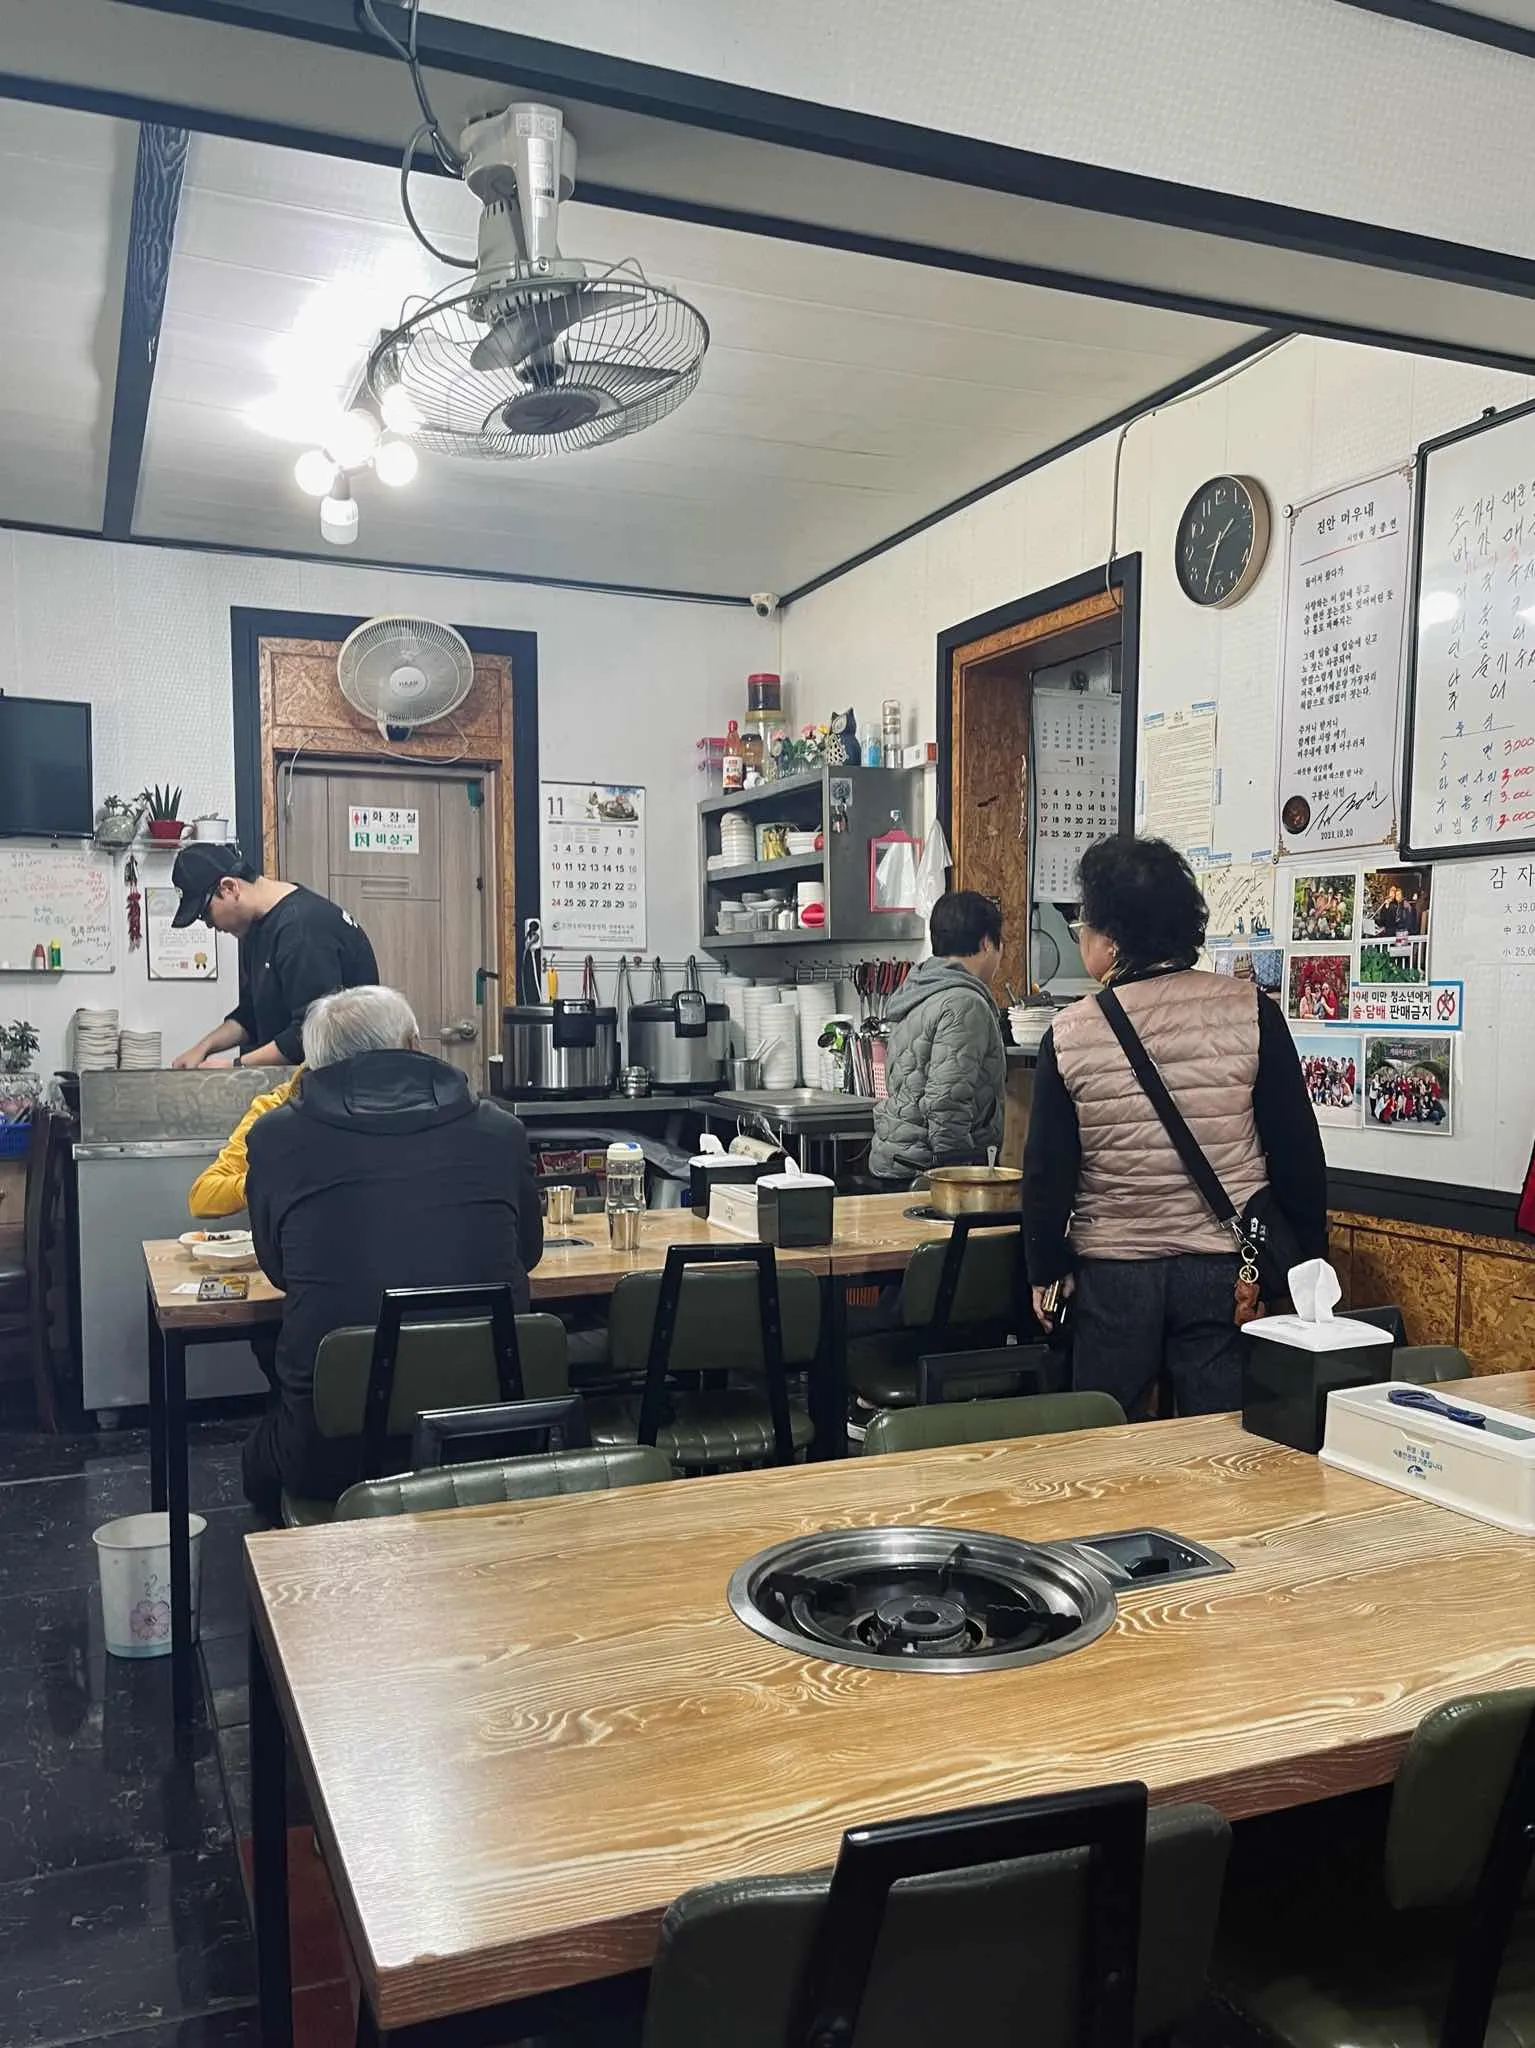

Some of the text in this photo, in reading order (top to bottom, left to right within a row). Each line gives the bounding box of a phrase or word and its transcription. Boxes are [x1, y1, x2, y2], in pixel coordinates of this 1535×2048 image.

[1215, 487, 1226, 506] 12
[1234, 487, 1238, 505] 1
[1202, 499, 1211, 518] 11
[1191, 522, 1205, 540] 10
[1317, 515, 1336, 535] 진안
[1185, 545, 1194, 561] 9
[1190, 567, 1198, 581] 8
[1215, 579, 1224, 594] 6
[1076, 757, 1084, 767] 11
[548, 796, 563, 816] 11
[372, 811, 416, 824] 화장실
[376, 833, 413, 846] 비상구
[618, 829, 622, 837] 1
[553, 844, 558, 852] 3
[566, 844, 571, 852] 4
[579, 845, 584, 853] 5
[604, 846, 609, 854] 7
[552, 862, 560, 870] 10
[565, 863, 573, 871] 11
[590, 864, 599, 872] 13
[603, 864, 611, 872] 14
[565, 881, 573, 889] 18
[577, 881, 586, 889] 19
[602, 882, 611, 890] 21
[615, 883, 624, 891] 22
[564, 899, 573, 907] 25
[577, 899, 586, 907] 26
[1352, 991, 1432, 1003] 19세 미만 청소년에게
[1390, 1005, 1432, 1020] 판매금지
